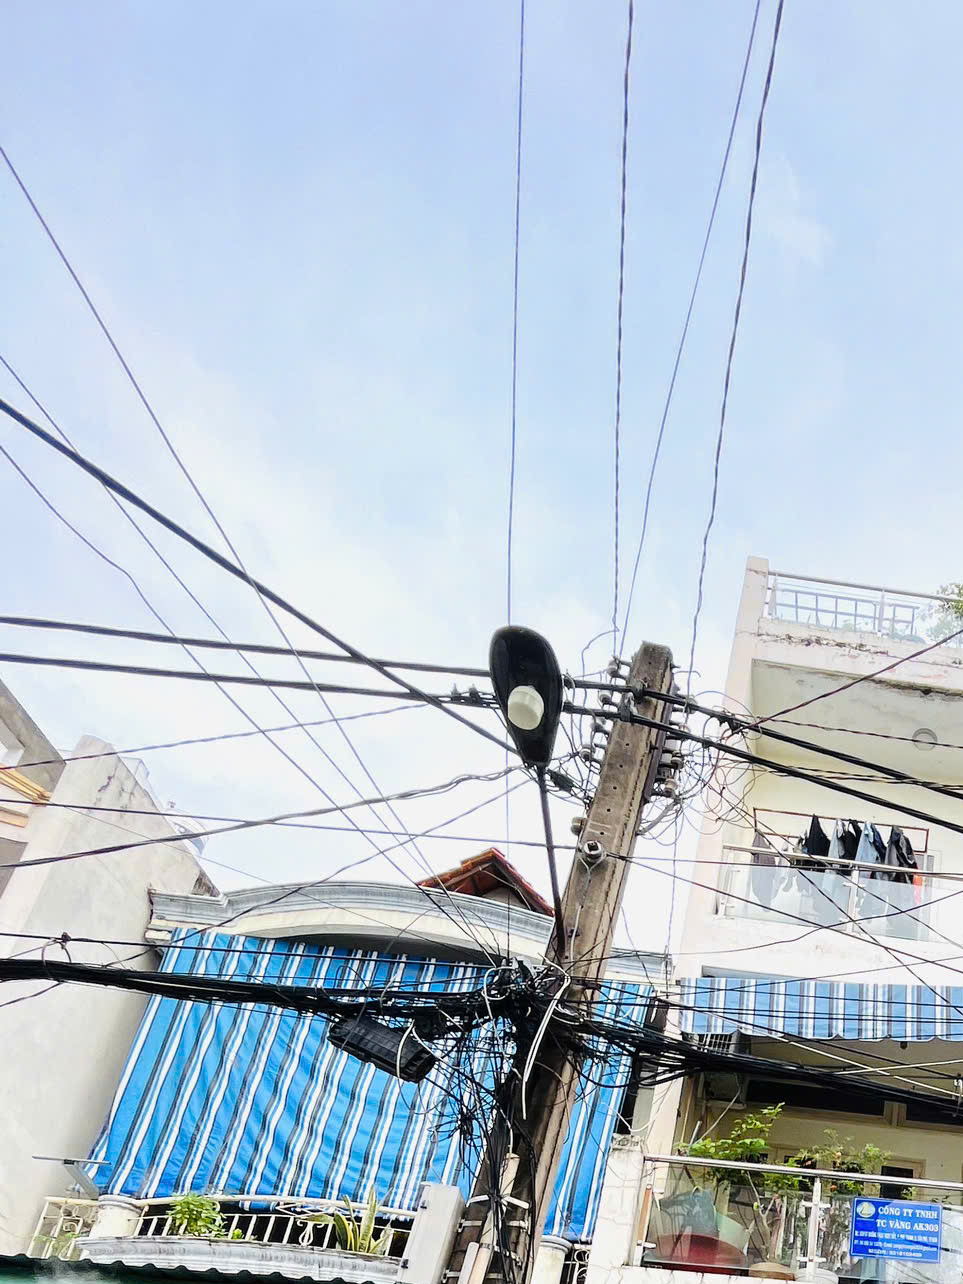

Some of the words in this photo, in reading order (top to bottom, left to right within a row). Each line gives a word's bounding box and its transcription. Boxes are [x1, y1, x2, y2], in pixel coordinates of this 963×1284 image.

[877, 1205, 900, 1216] CÔNG
[902, 1208, 914, 1216] TY
[915, 1209, 938, 1219] TNHH
[876, 1219, 887, 1227] TC
[889, 1218, 911, 1230] VÀNG
[913, 1223, 939, 1232] AK303
